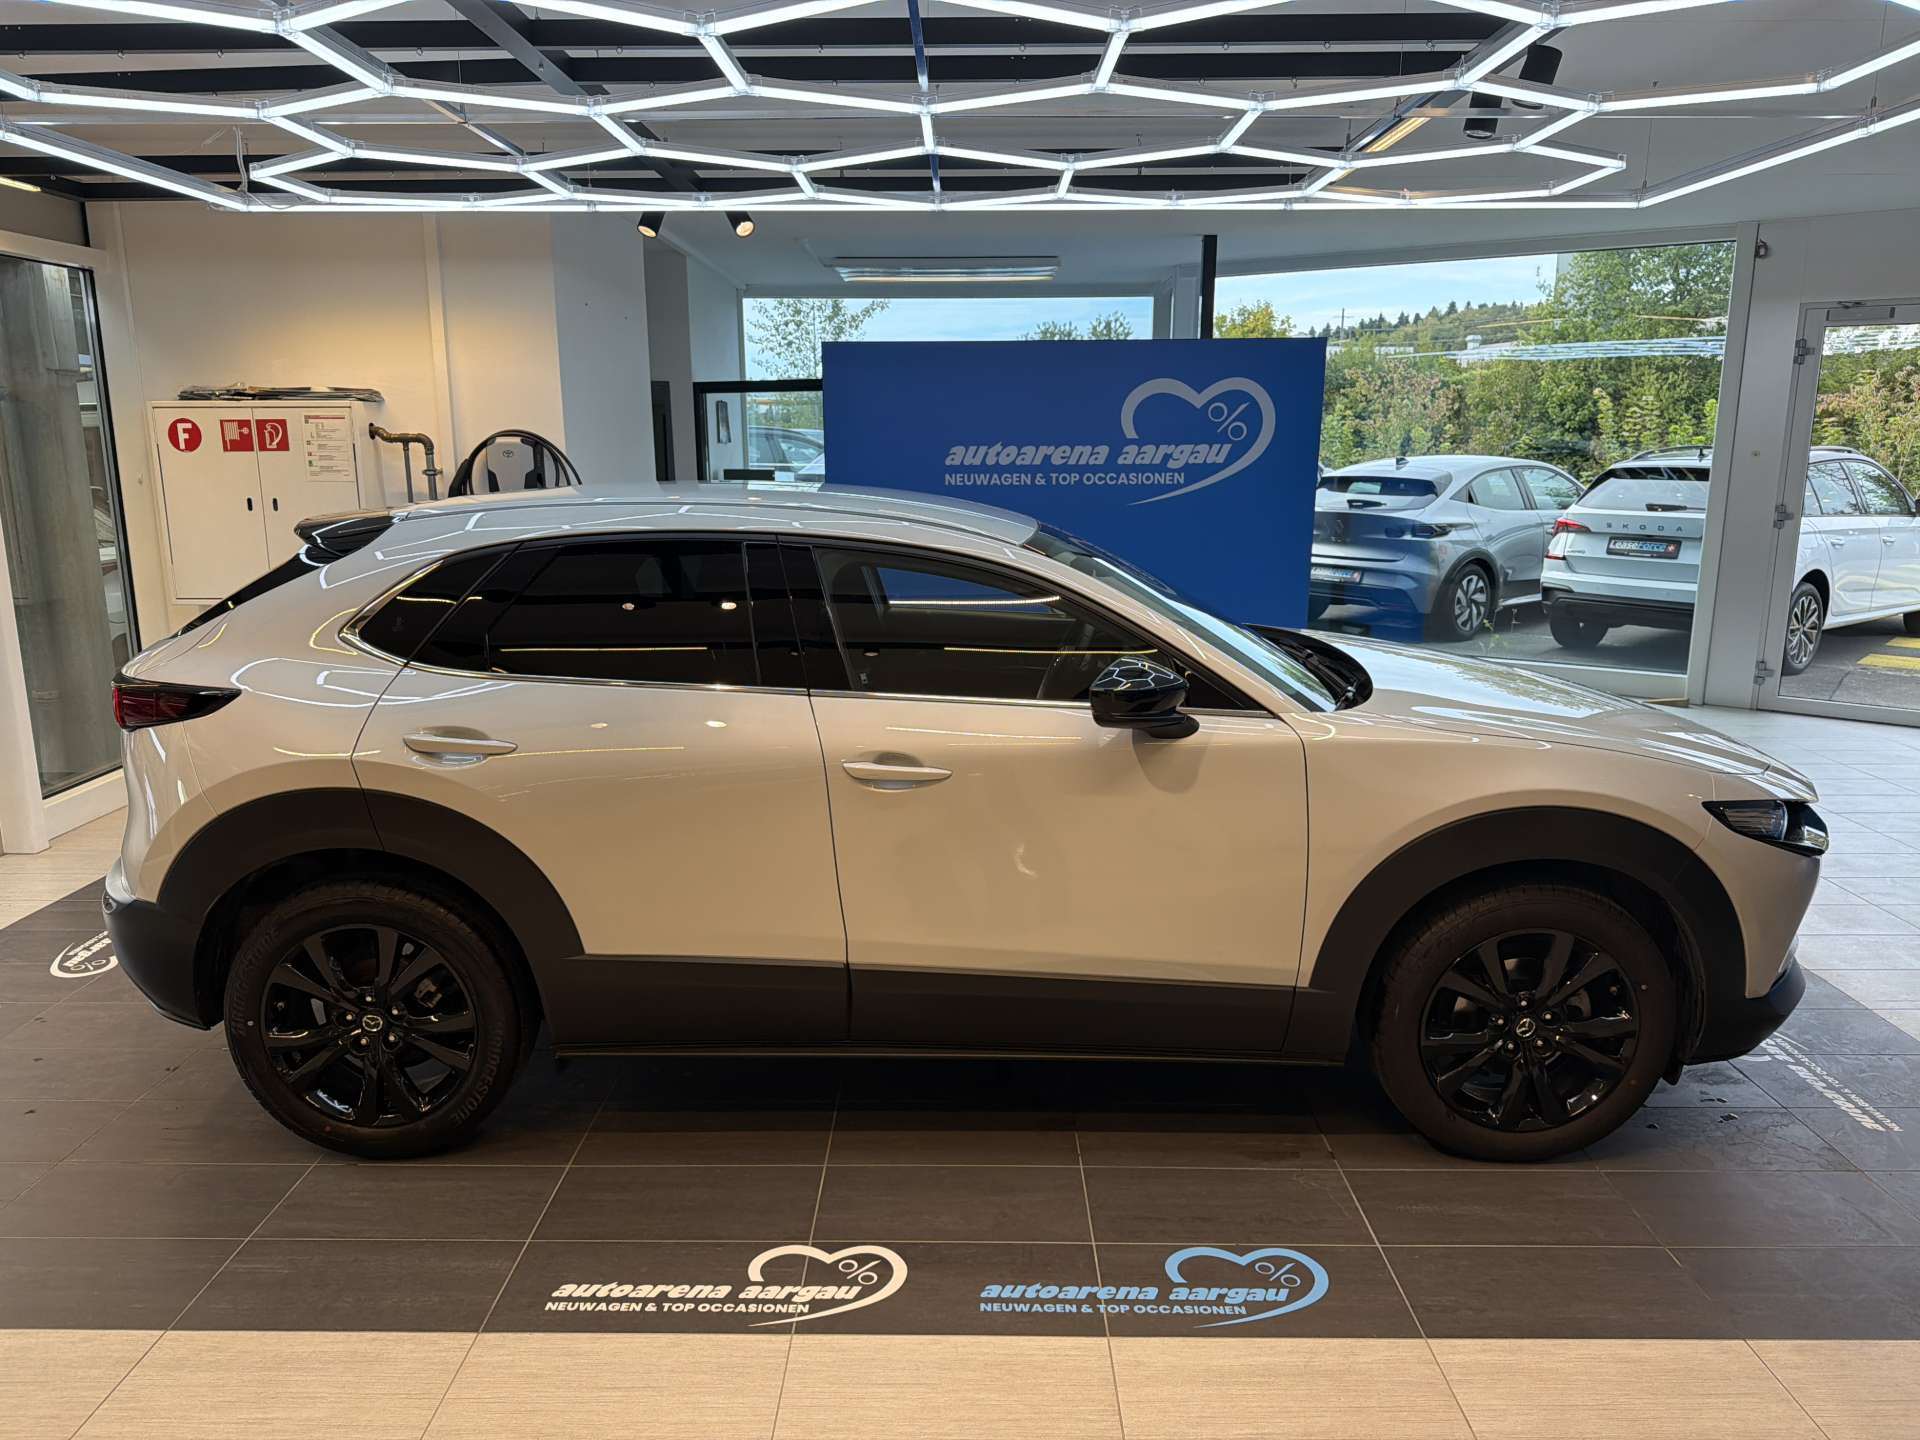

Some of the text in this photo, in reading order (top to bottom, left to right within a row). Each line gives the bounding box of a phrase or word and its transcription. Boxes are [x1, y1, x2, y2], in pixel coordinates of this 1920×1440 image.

[177, 422, 193, 449] F
[945, 441, 1232, 469] autoarena aargau
[945, 472, 1185, 486] NEUWAGEN & TOP OCCASIONEN
[1609, 540, 1666, 551] LeaseForce
[551, 1281, 862, 1303] autoarena aargau
[980, 1281, 1290, 1305] autoarena aargau
[545, 1302, 810, 1314] NEUWAGEN & TOP OCCASIONEN
[980, 1302, 1248, 1315] NEUWAGEN & TOP OCCASIONEN
